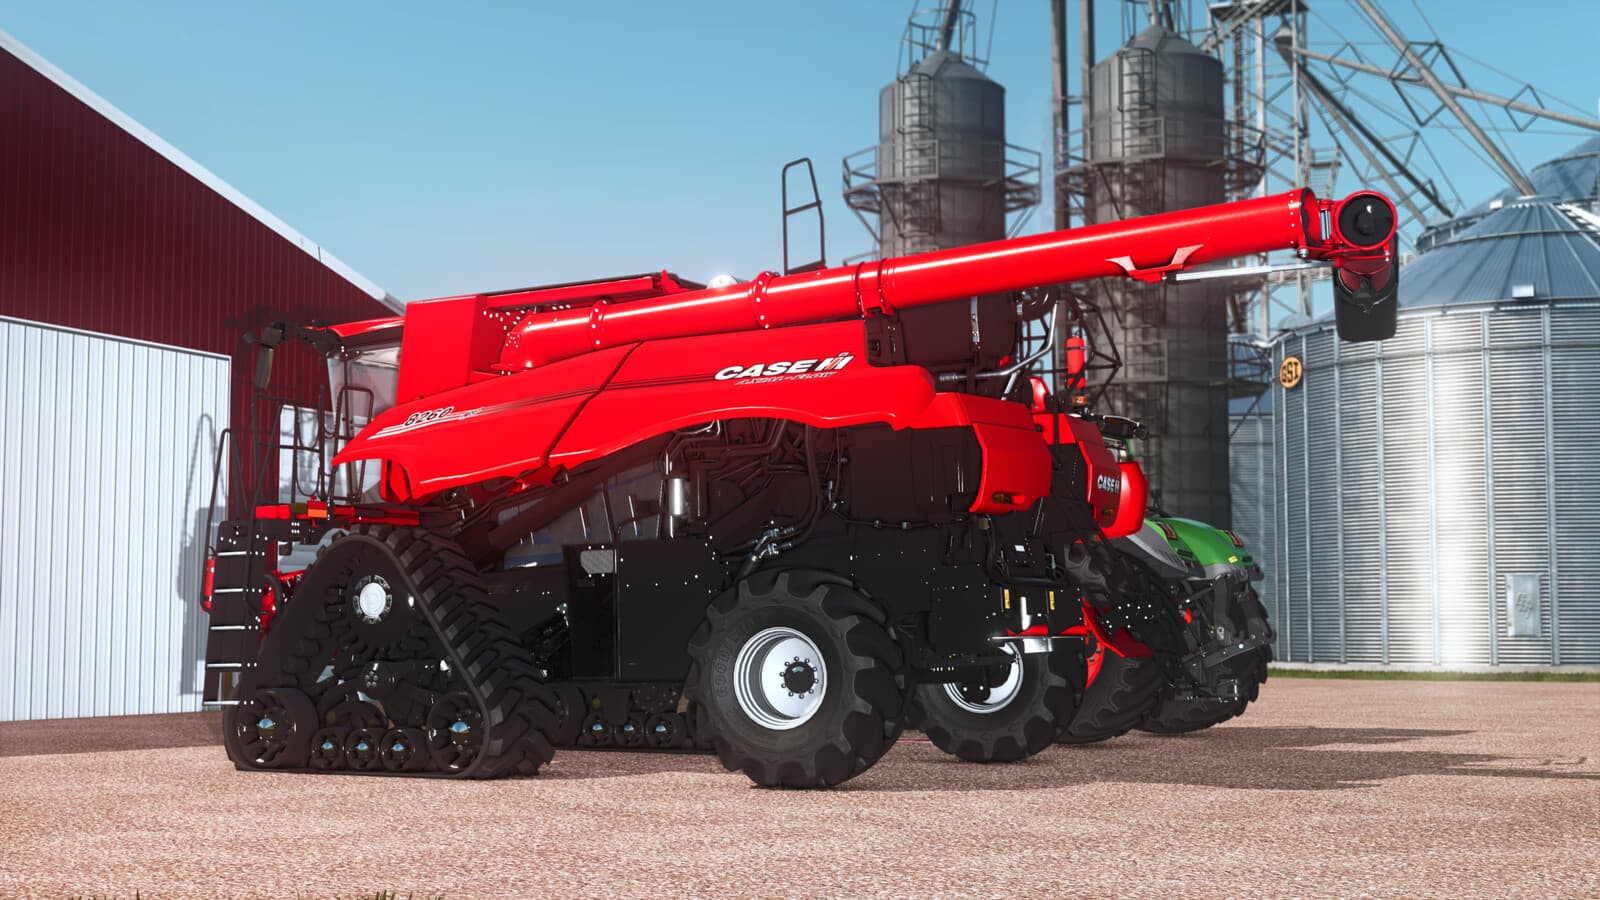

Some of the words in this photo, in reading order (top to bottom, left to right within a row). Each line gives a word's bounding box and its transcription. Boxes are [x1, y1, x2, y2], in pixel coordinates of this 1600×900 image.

[714, 359, 818, 381] CASE
[1280, 361, 1299, 383] GSI
[403, 406, 455, 427] 8260
[1097, 474, 1115, 493] CASE
